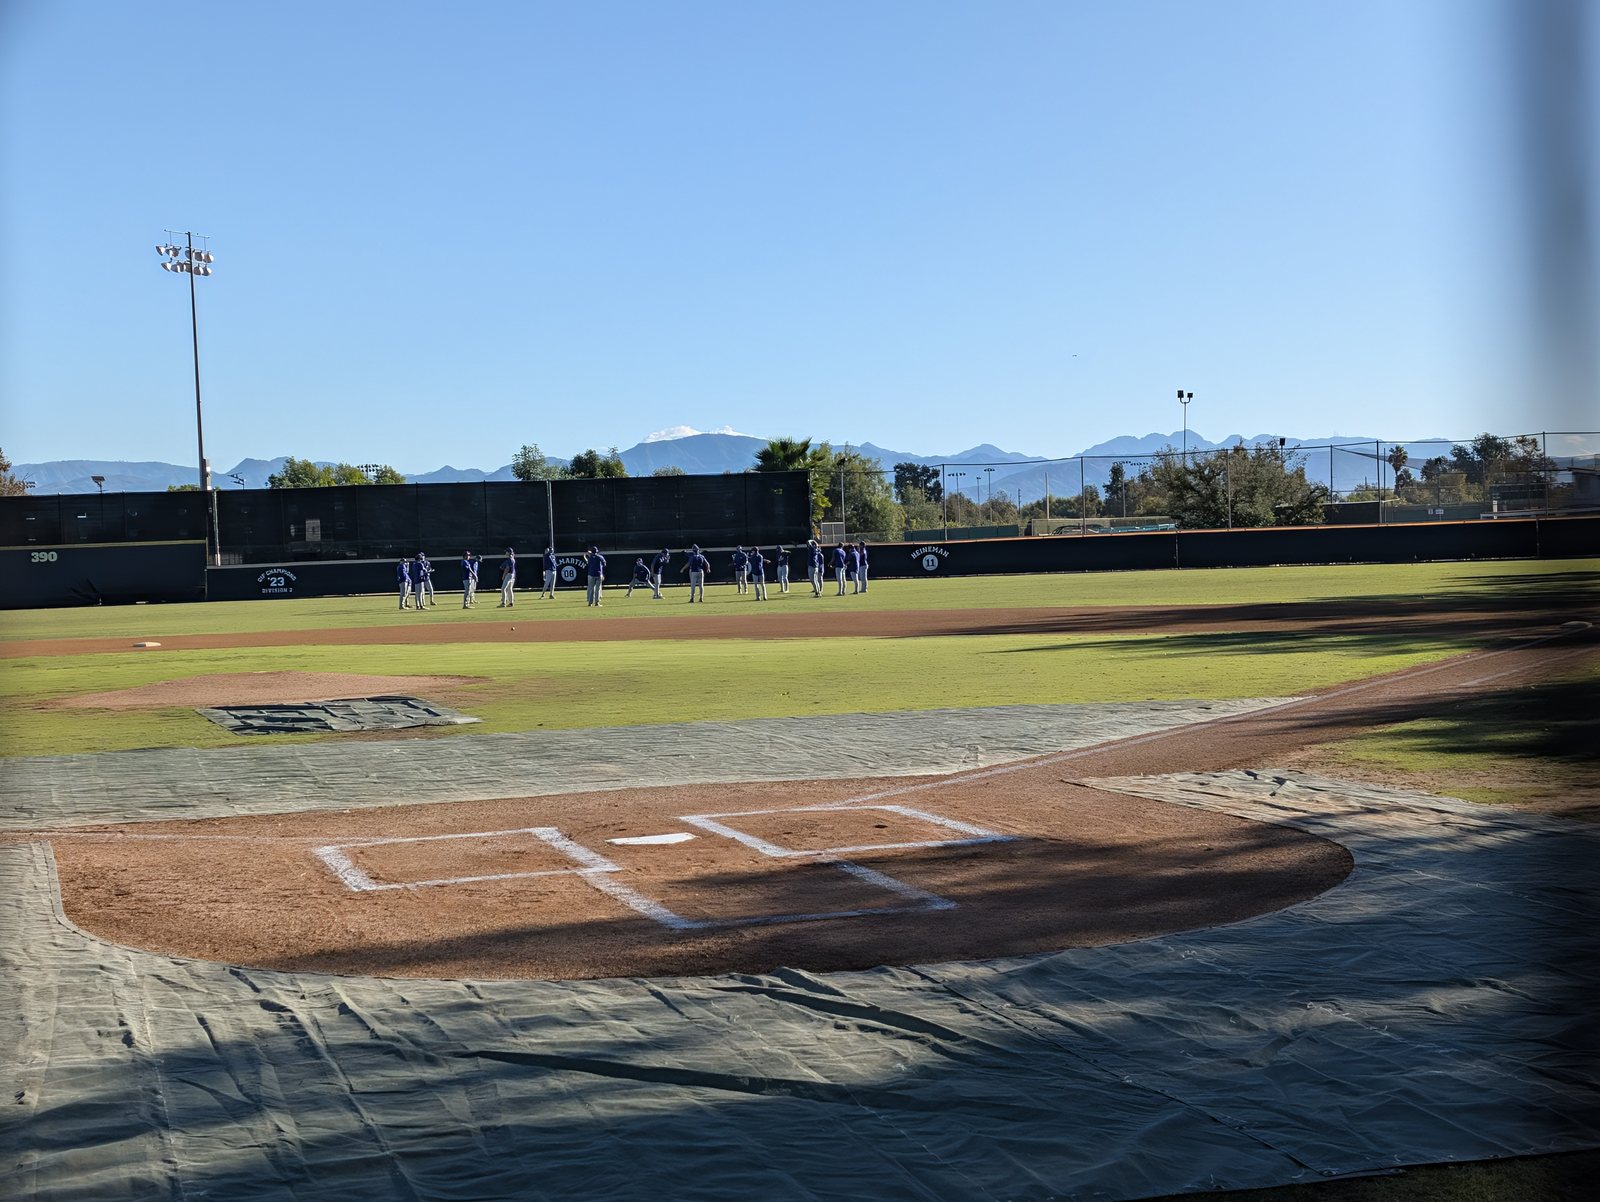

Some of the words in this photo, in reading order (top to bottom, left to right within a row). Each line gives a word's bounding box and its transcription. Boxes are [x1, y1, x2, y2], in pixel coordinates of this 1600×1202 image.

[31, 551, 58, 563] 390
[911, 546, 949, 559] HEINEMAN
[925, 558, 935, 567] 11
[265, 568, 297, 581] CHAMPIONS
[564, 569, 575, 578] 08
